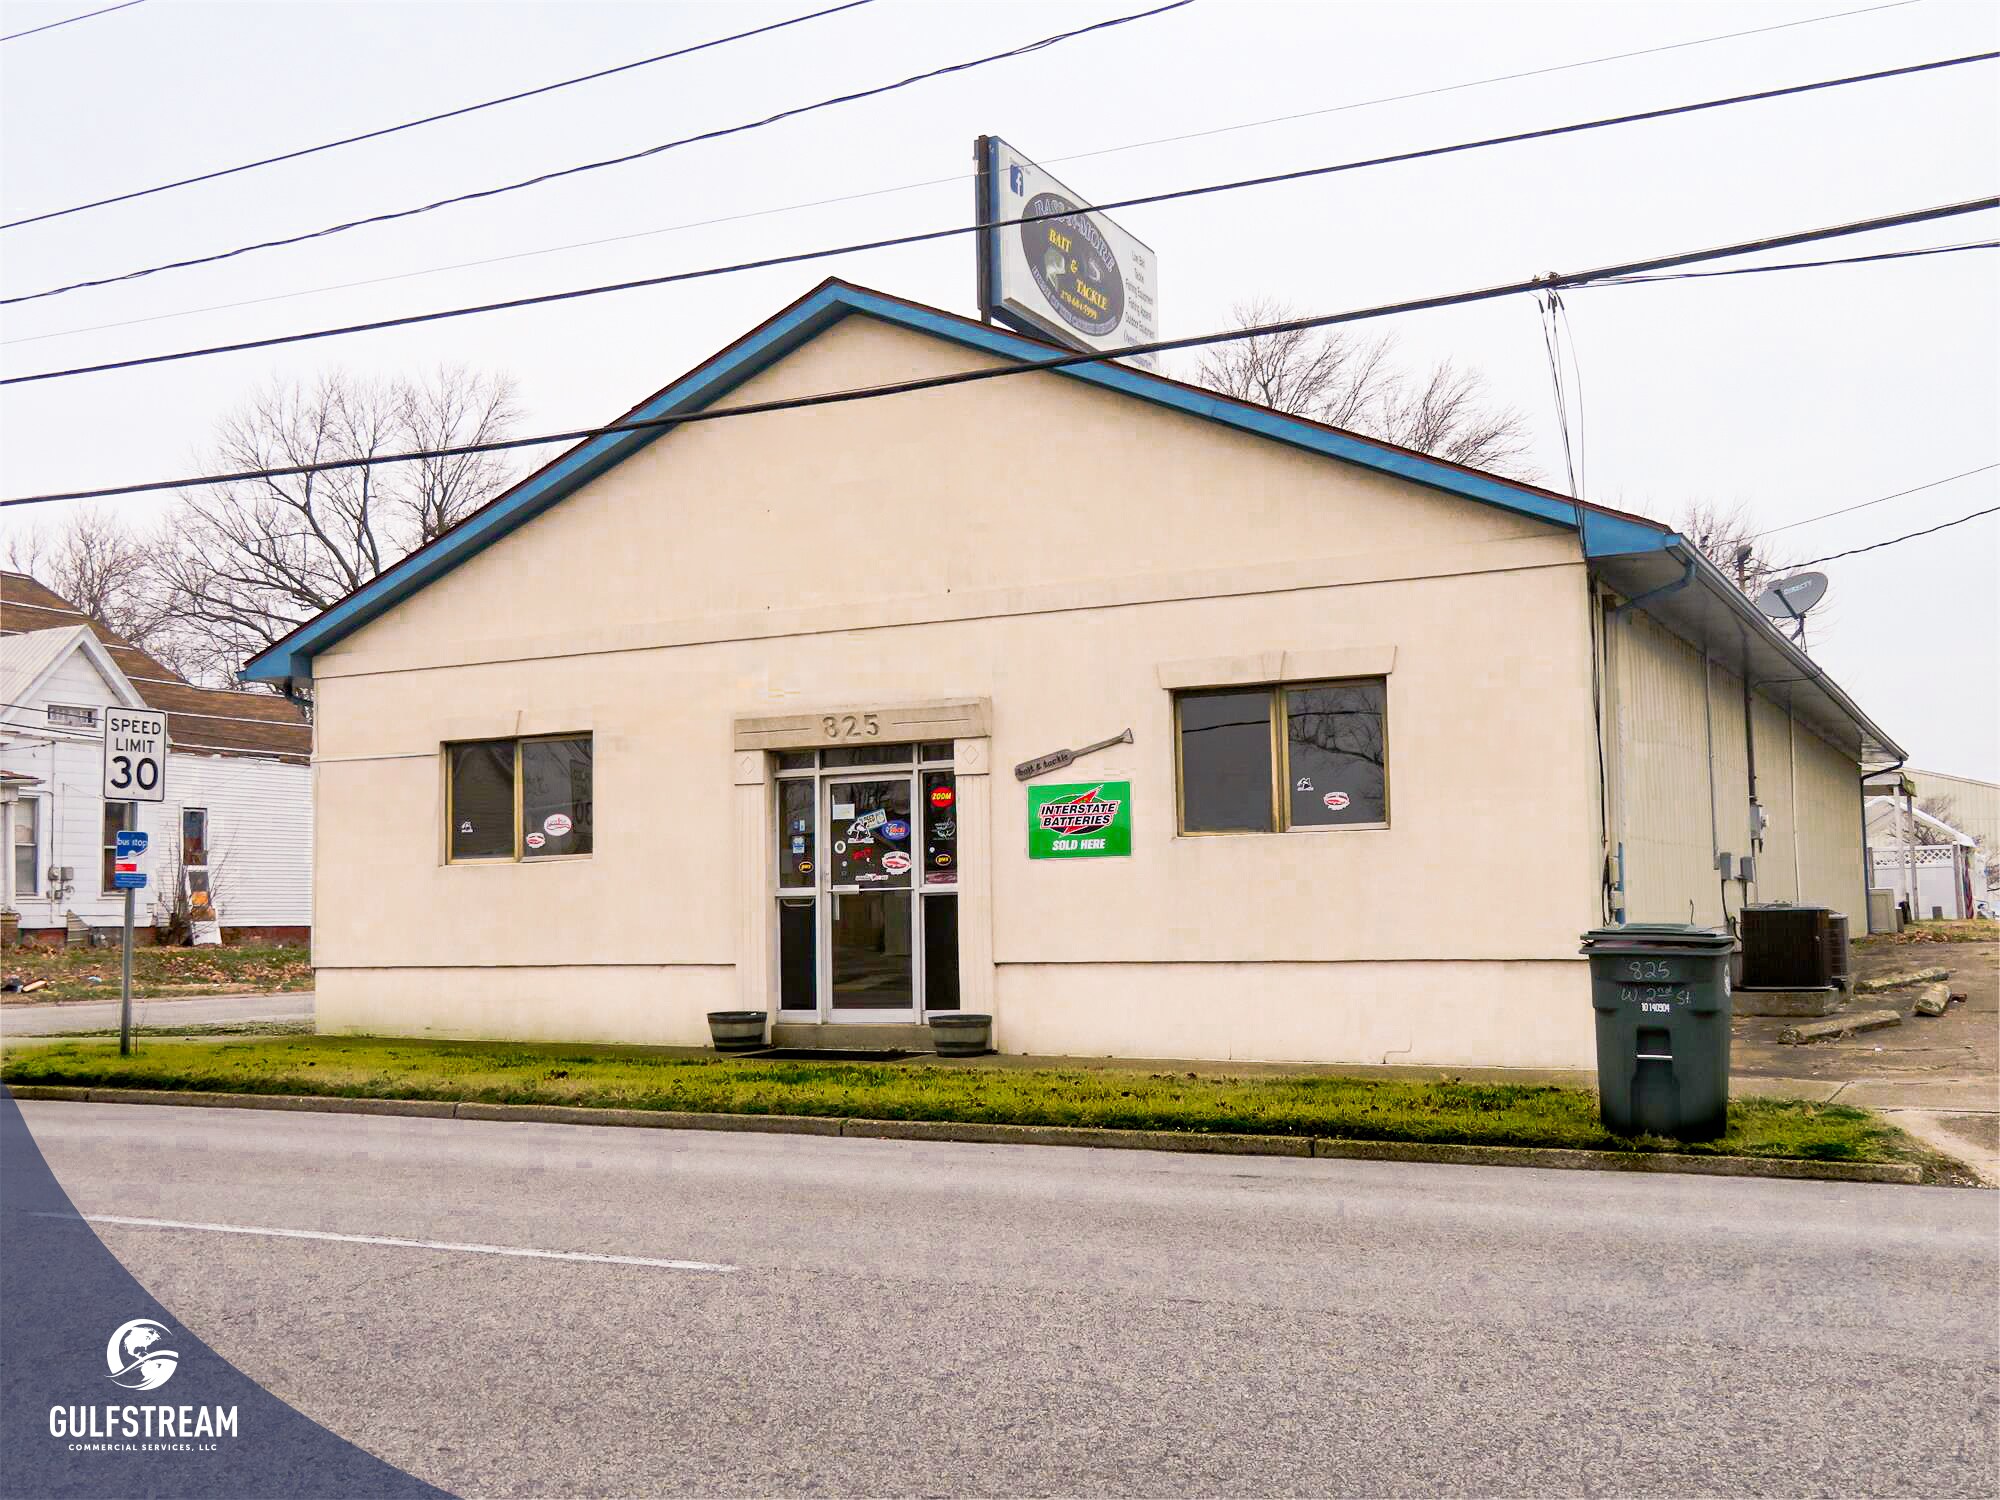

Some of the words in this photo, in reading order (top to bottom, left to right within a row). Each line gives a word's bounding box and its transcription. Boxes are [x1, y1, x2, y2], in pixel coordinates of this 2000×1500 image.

[1048, 228, 1072, 253] BAIT
[1076, 278, 1108, 311] TACKLE
[110, 717, 162, 735] SPEED
[822, 713, 880, 739] 825
[115, 737, 155, 753] LIMIT
[110, 755, 158, 790] 30
[931, 791, 952, 801] ZOOM
[1041, 802, 1116, 815] INTERSTATE
[1043, 814, 1111, 827] BATTERIES
[117, 837, 130, 846] bus
[132, 839, 148, 848] stop
[1052, 839, 1079, 851] SOLD
[1080, 838, 1106, 850] HERE
[1629, 961, 1671, 980] 825
